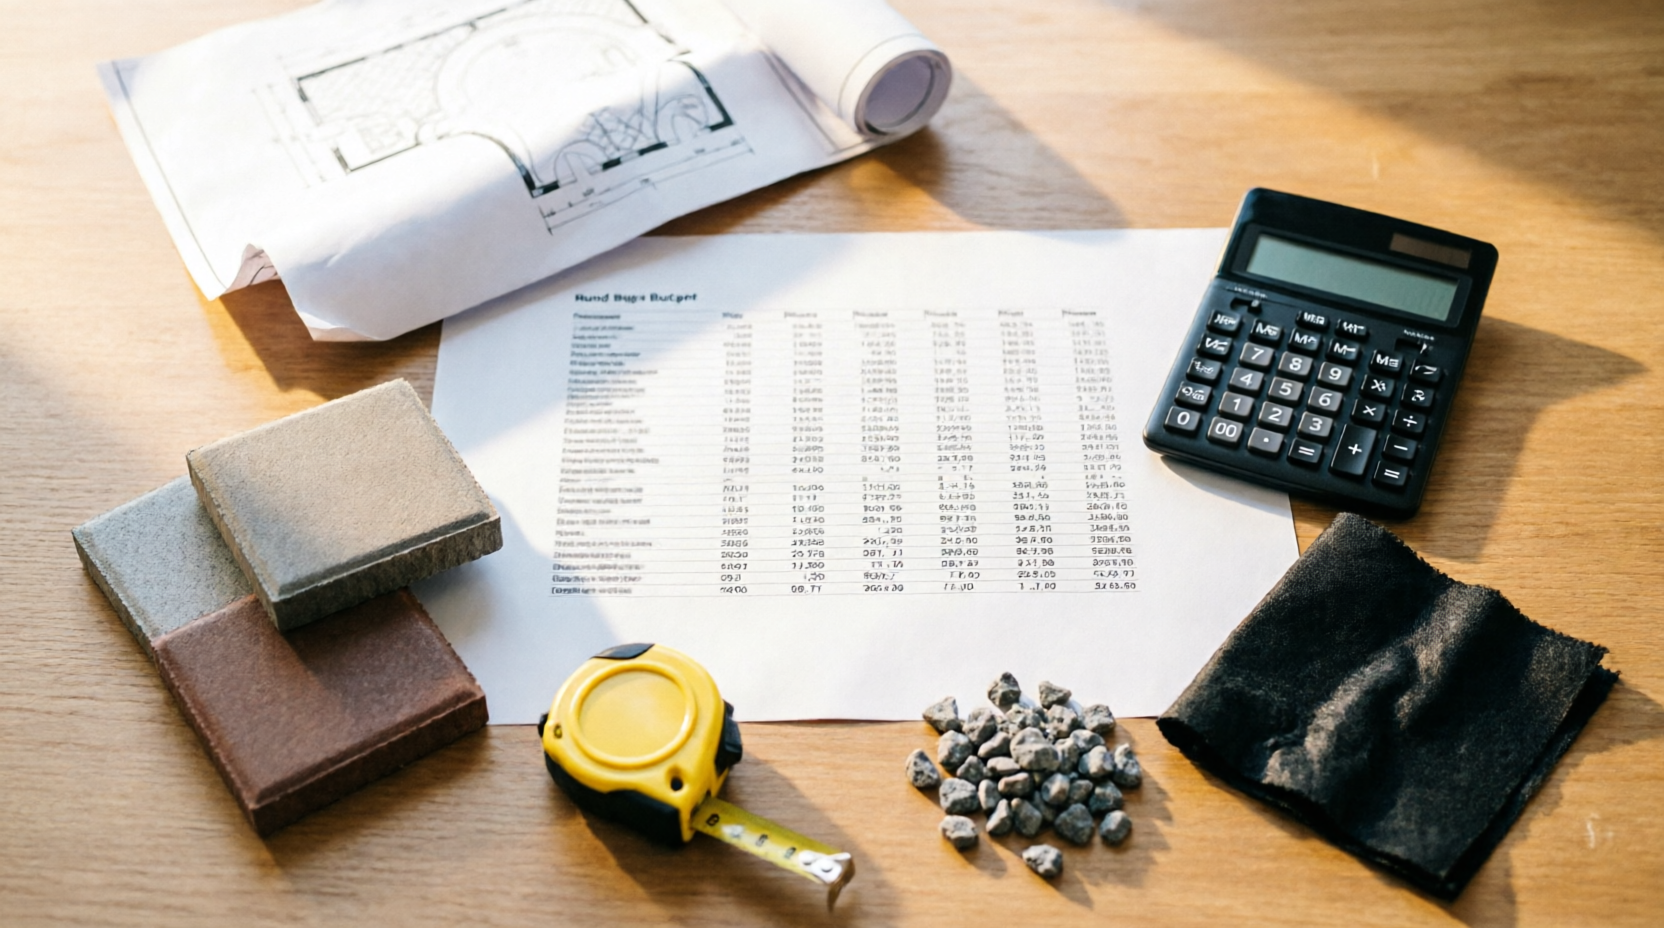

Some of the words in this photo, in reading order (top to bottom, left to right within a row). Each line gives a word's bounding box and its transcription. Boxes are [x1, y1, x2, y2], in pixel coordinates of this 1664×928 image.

[1251, 347, 1265, 360] 7
[1289, 357, 1303, 371] 8
[1239, 372, 1253, 386] 4
[1328, 367, 1342, 381] 9
[1278, 382, 1293, 396] 5
[1233, 397, 1242, 411] 1
[1318, 392, 1333, 407] 6
[1176, 411, 1191, 425] 0
[1267, 407, 1283, 422] 2
[1214, 422, 1237, 437] 00
[1308, 417, 1323, 432] 3
